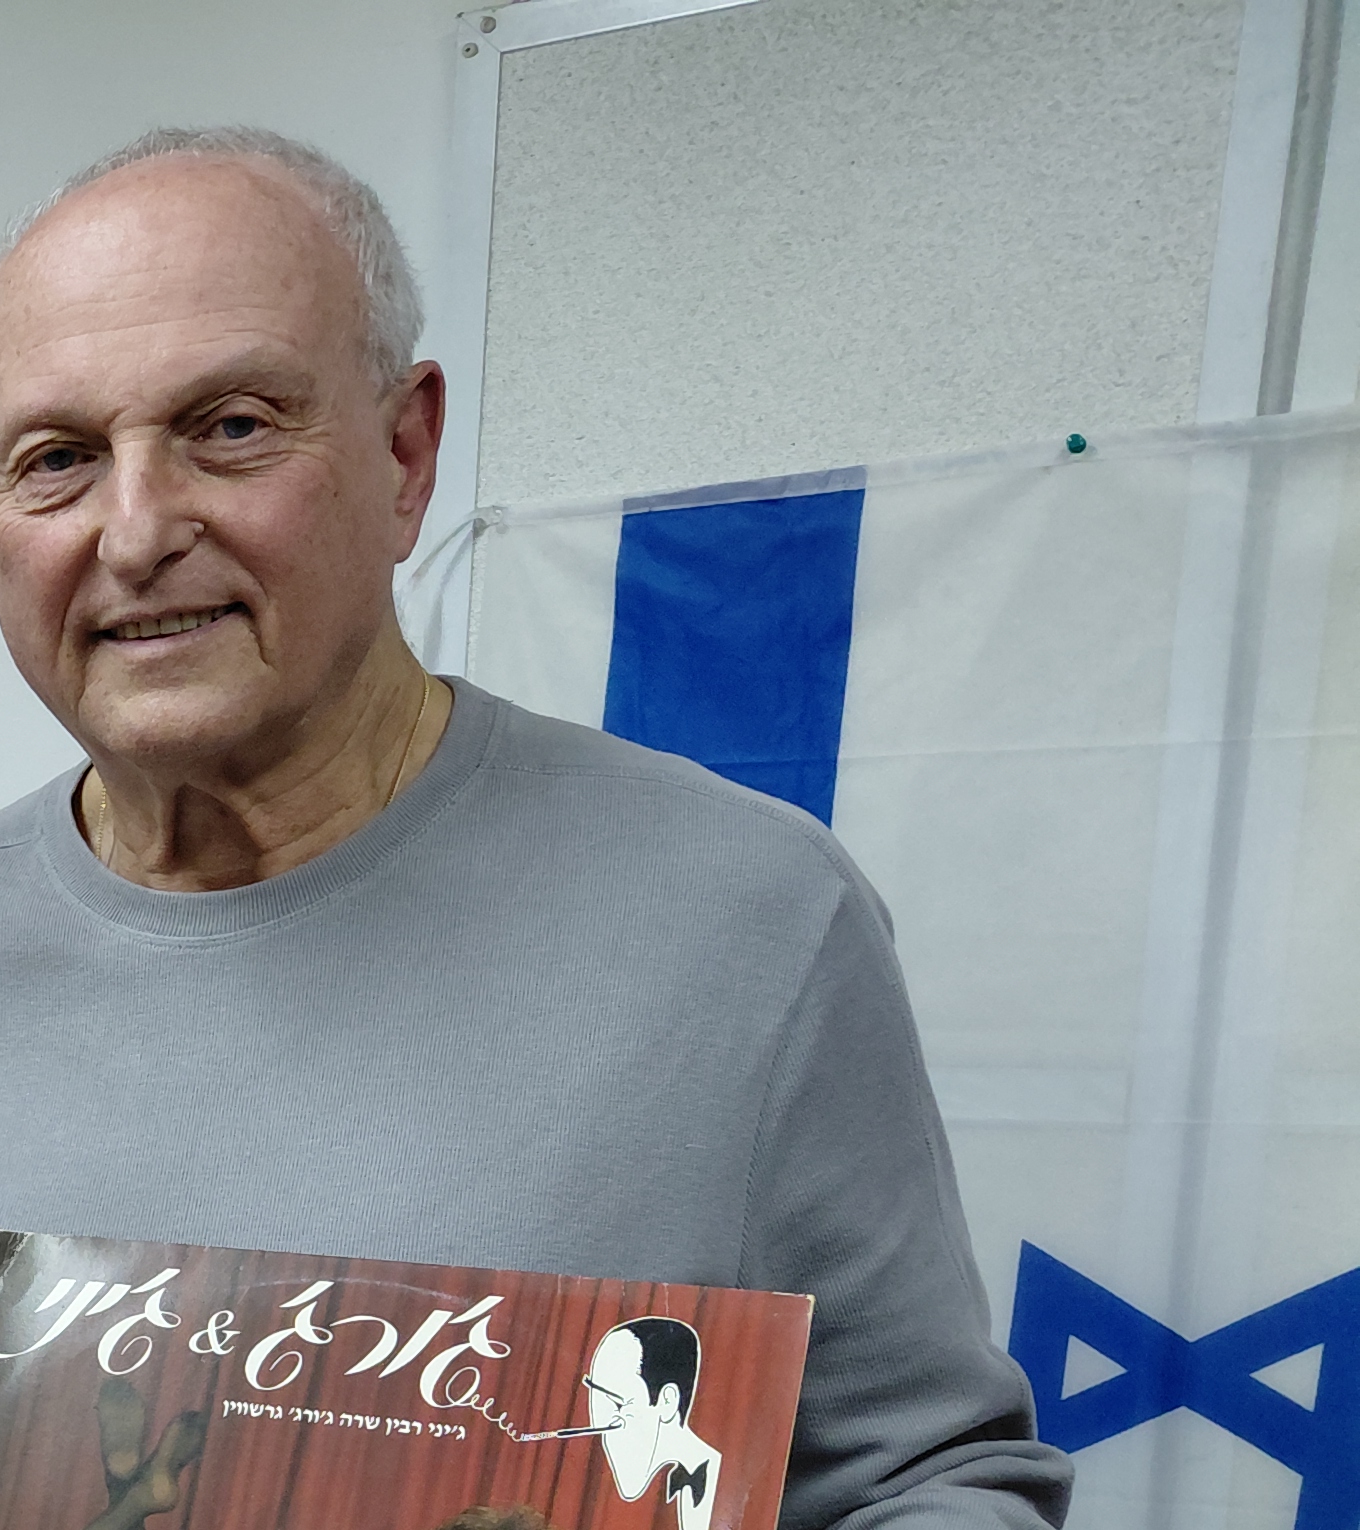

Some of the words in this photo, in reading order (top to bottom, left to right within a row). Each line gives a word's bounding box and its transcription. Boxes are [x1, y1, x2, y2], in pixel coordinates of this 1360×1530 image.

[188, 1310, 241, 1354] &
[223, 1399, 283, 1420] גרשווין
[288, 1407, 334, 1426] ג'ורג'
[340, 1412, 380, 1431] שרה
[385, 1418, 423, 1437] רבין
[428, 1422, 466, 1440] ג'יני
